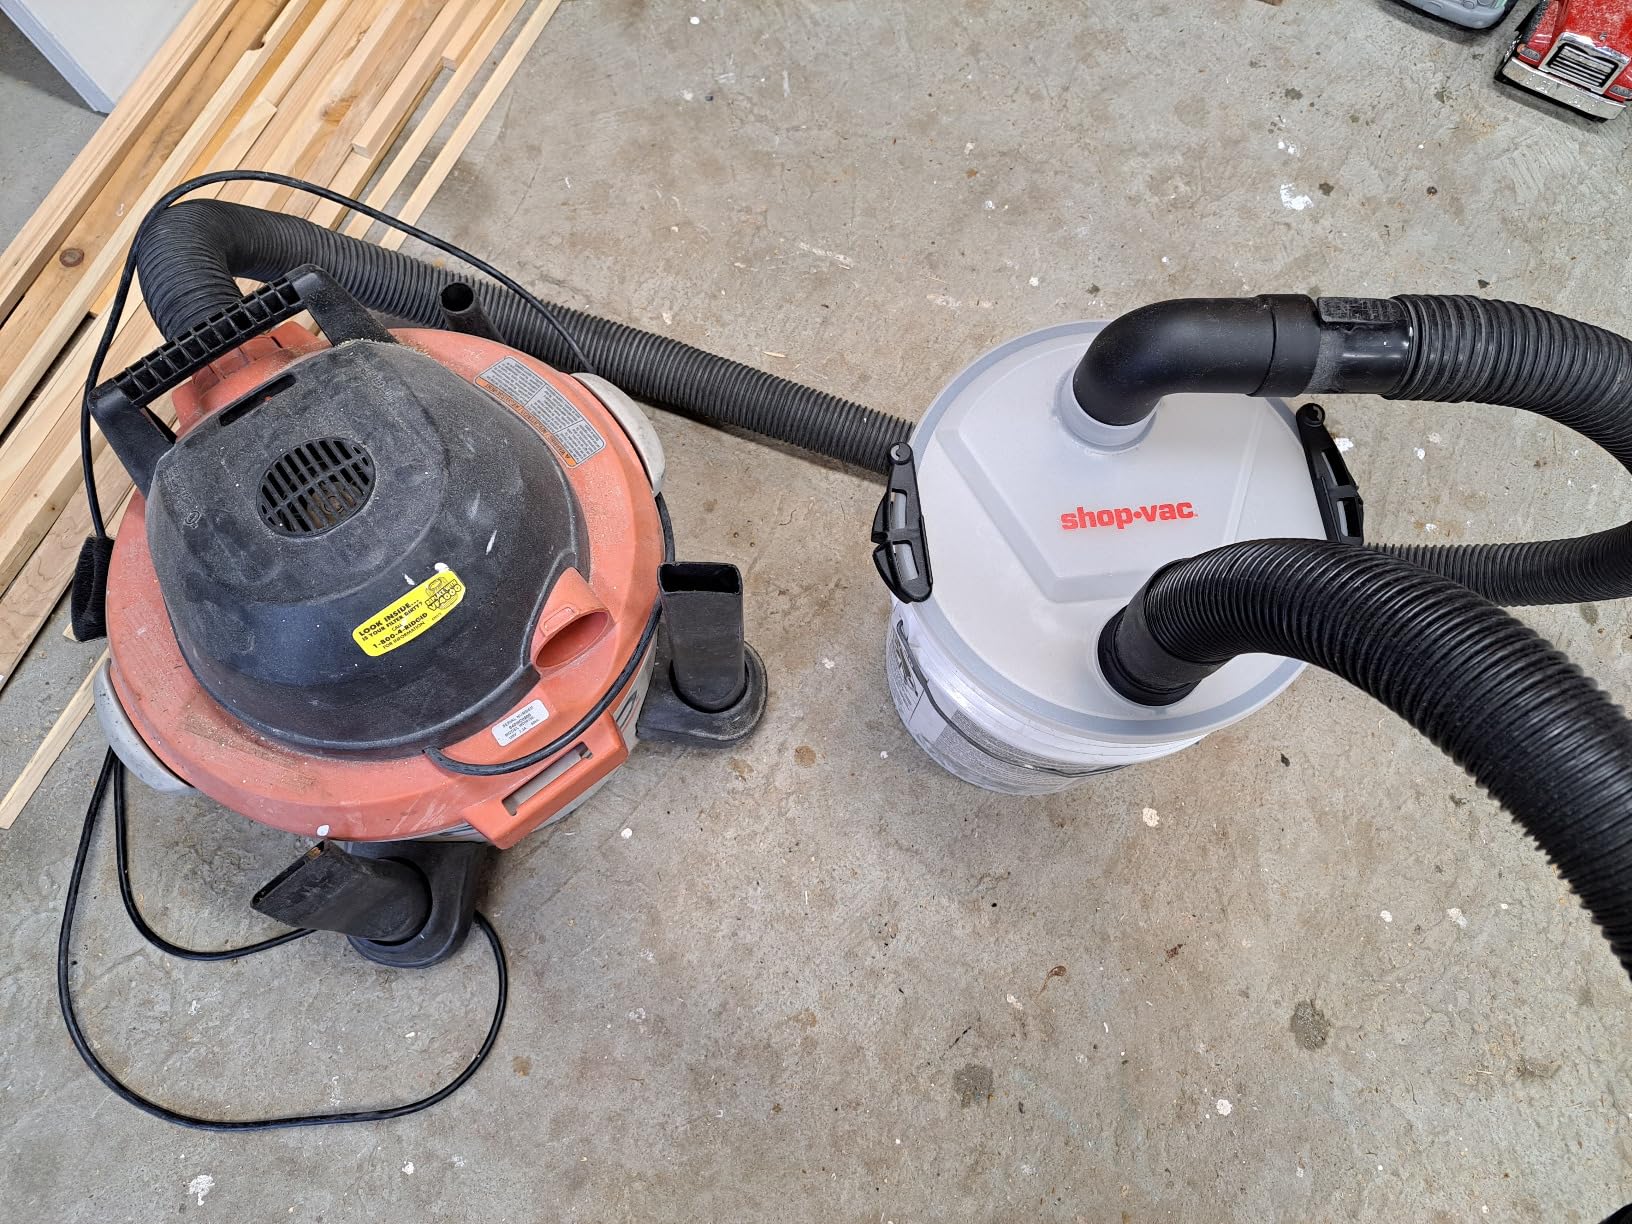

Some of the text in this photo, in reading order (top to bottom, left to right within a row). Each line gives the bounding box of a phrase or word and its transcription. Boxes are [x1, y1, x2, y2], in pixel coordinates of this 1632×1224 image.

[426, 587, 447, 606] REPLACE
[427, 584, 462, 611] VF4000
[359, 620, 383, 636] LOOK
[369, 627, 386, 638] YOUR
[386, 615, 404, 627] FILTER
[405, 601, 423, 616] DIRTY?
[373, 612, 428, 649] 1-800-4-RIDGID
[393, 621, 426, 643] INFORMATION
